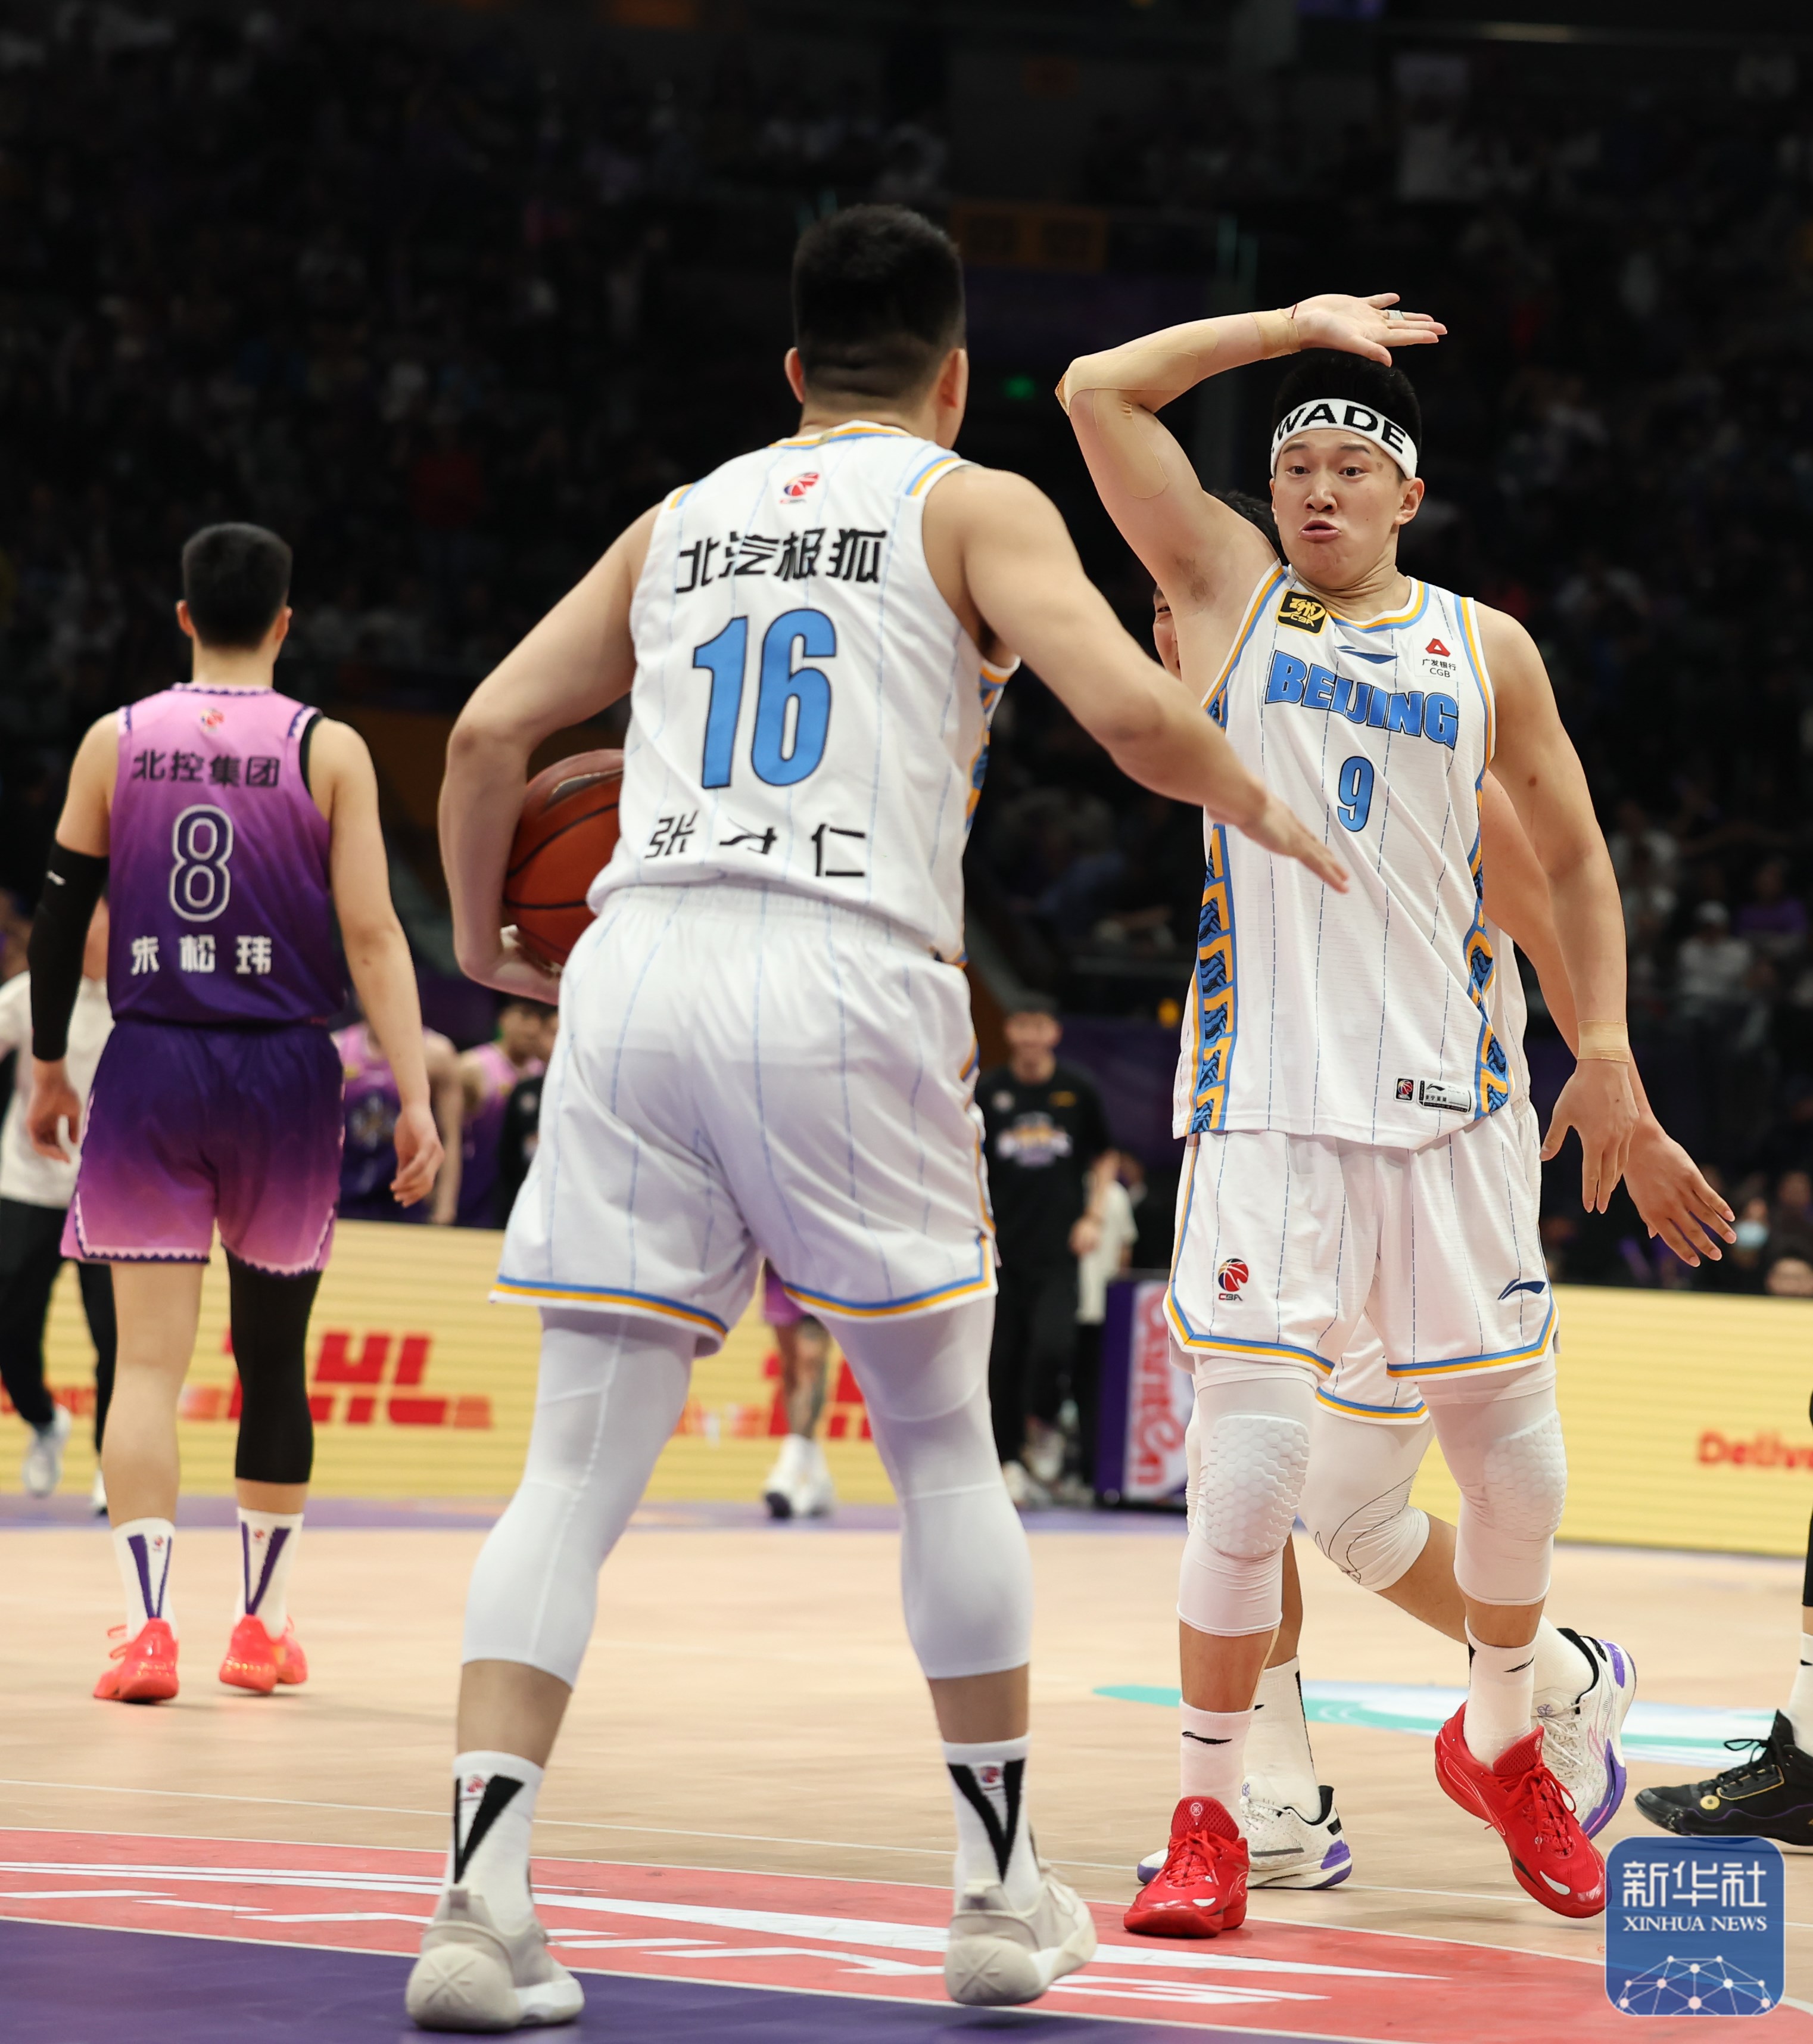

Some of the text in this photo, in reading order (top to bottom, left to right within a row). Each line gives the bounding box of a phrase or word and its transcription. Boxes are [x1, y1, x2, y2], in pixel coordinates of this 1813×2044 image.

[1278, 403, 1406, 454] WADE
[675, 527, 887, 594] 北汽极狐
[1422, 658, 1457, 671] 广发银行
[1429, 667, 1451, 678] CGB
[693, 608, 837, 789] 16
[1264, 649, 1459, 751] BEIJING
[133, 748, 281, 788] 北控集团
[1337, 755, 1375, 832] 9
[169, 803, 234, 923] 8
[1218, 1293, 1243, 1301] CBA
